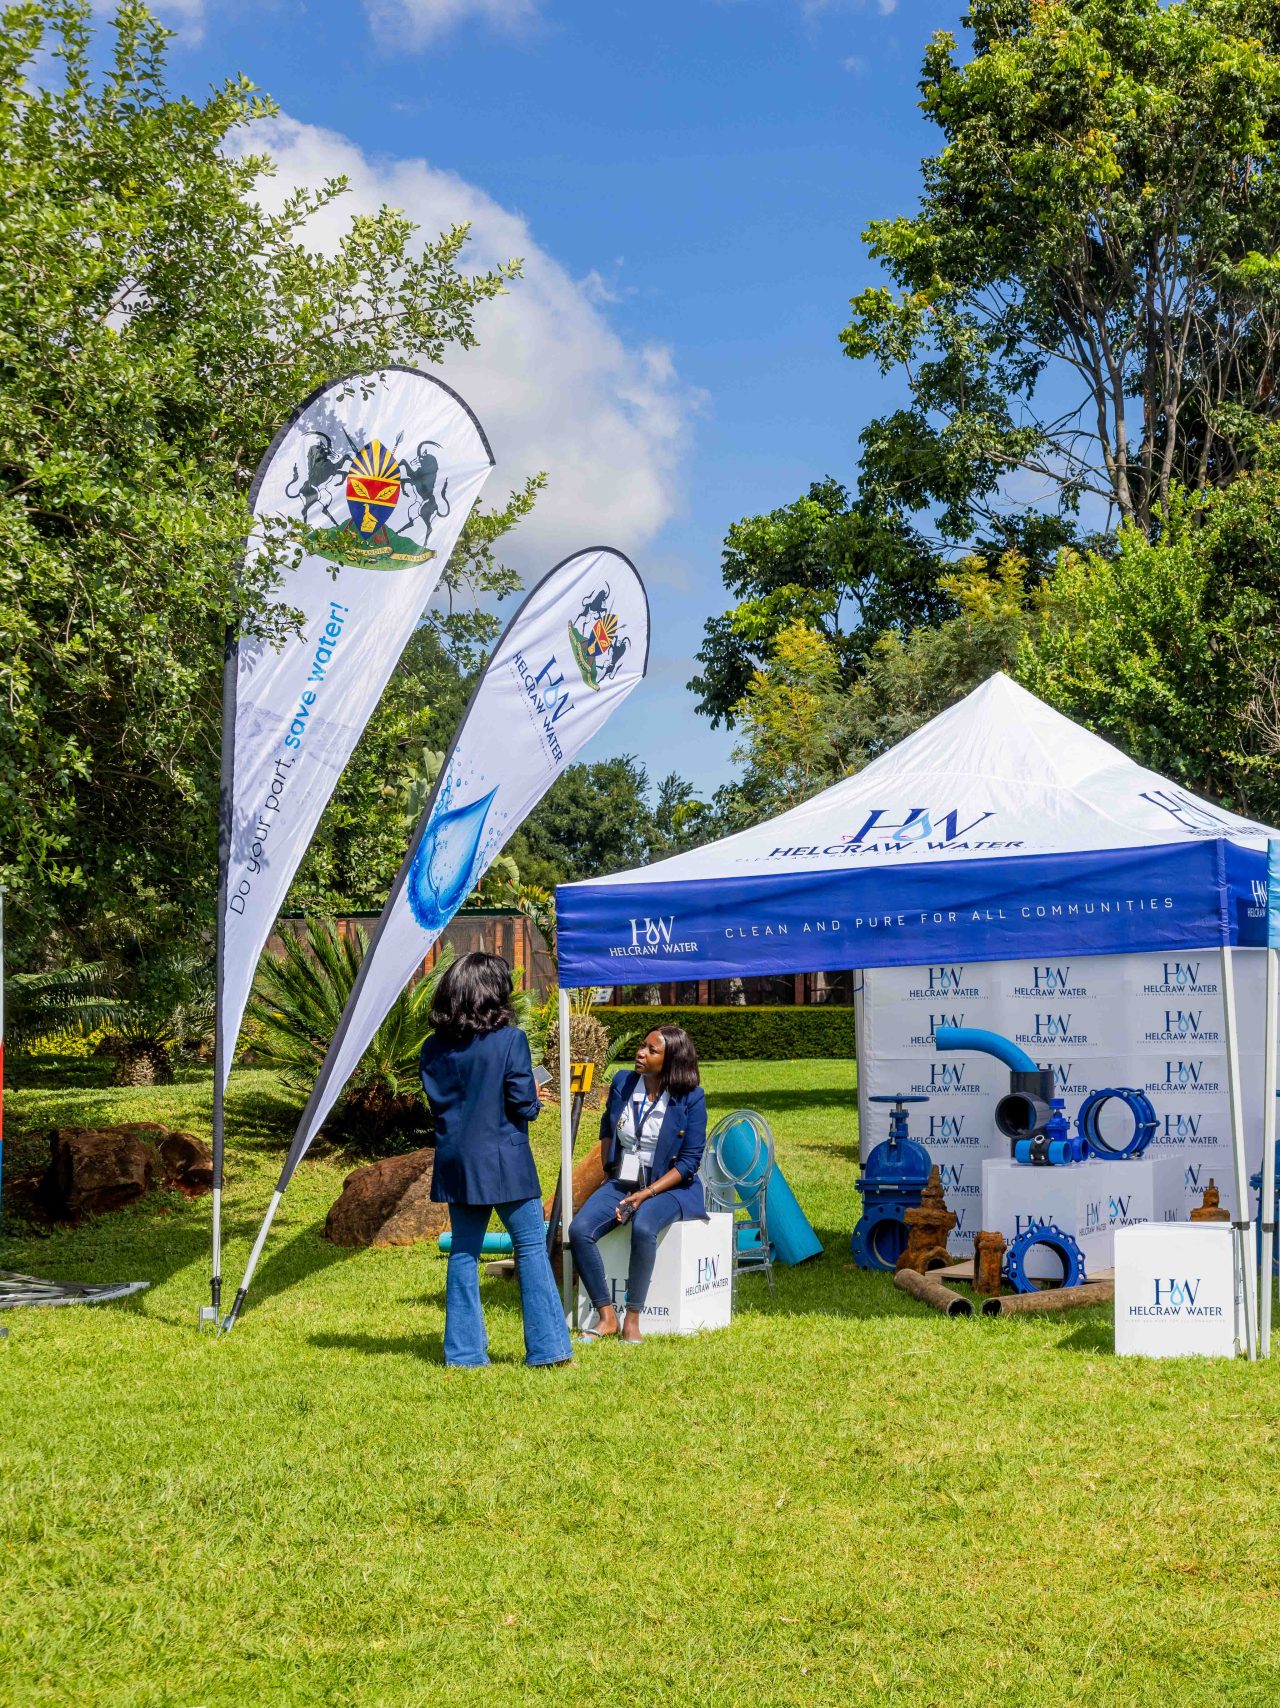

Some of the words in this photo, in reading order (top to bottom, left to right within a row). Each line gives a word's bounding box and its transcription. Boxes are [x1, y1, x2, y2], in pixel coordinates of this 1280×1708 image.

[512, 650, 546, 715] HELCRAW
[543, 716, 563, 764] WATER
[230, 880, 251, 915] Do
[246, 817, 272, 875] your
[264, 757, 296, 813] part,
[284, 690, 317, 750] save
[307, 601, 350, 682] water!
[768, 842, 915, 857] HELCRAW
[927, 840, 1025, 851] WATER
[725, 924, 788, 939] CLEAN
[803, 920, 840, 933] AND
[856, 915, 906, 929] PURE
[921, 912, 957, 923] FOR
[972, 908, 1006, 921] ALL
[1021, 897, 1174, 919] COMMUNITIES
[609, 945, 658, 957] HELCRAW
[663, 942, 698, 954] WATER
[909, 989, 949, 998] HELCRAW
[953, 988, 979, 997] WATER
[1014, 987, 1055, 996] HELCRAW
[1060, 988, 1087, 997] WATER
[1143, 985, 1186, 994] HELCRAW
[1188, 984, 1218, 993] WATER
[1015, 1034, 1056, 1043] HELCRAW
[1060, 1035, 1087, 1043] WATER
[1145, 1032, 1187, 1041] HELCRAW
[1190, 1032, 1219, 1040] WATER
[911, 1085, 950, 1093] HELCRAW
[953, 1084, 980, 1092] WATER
[1060, 1085, 1088, 1093] WATER
[1145, 1083, 1187, 1092] HELCRAW
[1190, 1083, 1219, 1091] WATER
[953, 1136, 980, 1145] WATER
[1189, 1136, 1218, 1144] WATER
[952, 1185, 980, 1194] WATER
[685, 1282, 710, 1297] HELCRAW
[711, 1277, 729, 1289] WATER
[1129, 1306, 1181, 1316] HELCRAW
[1186, 1306, 1222, 1316] WATER
